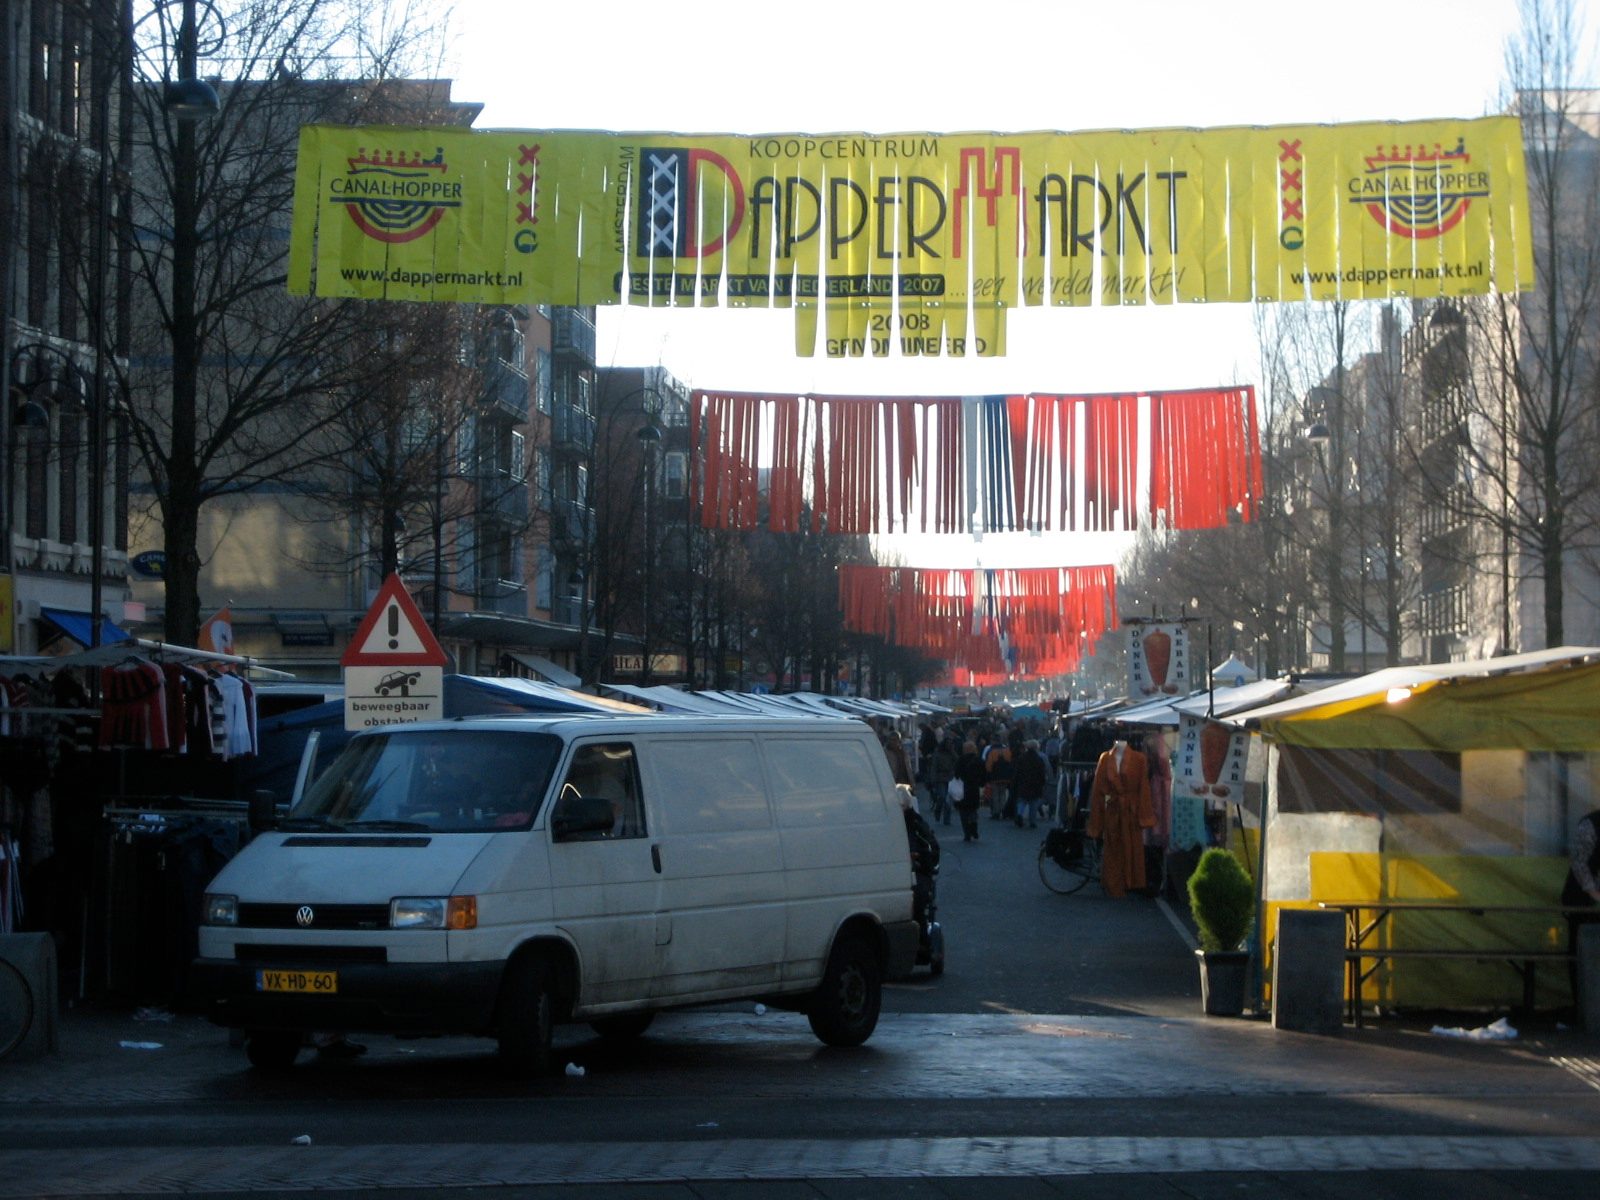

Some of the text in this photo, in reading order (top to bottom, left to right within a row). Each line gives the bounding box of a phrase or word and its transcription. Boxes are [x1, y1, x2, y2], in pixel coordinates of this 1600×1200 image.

[749, 139, 938, 160] KOOPCENTRUM
[330, 177, 463, 198] CANALHOPPER
[1348, 171, 1489, 194] CANALHOPPER
[615, 146, 634, 256] AMSTERDAM
[340, 266, 523, 287] www.dappermarkt.nl
[1290, 261, 1484, 286] www.dappermarkt.nl
[749, 278, 784, 293] VAN
[903, 278, 941, 293] 2007
[871, 313, 931, 331] 2008
[1175, 628, 1184, 679] KEBAB
[352, 701, 430, 713] beweegbaar
[1231, 736, 1244, 780] EBAB
[264, 972, 334, 990] VX-HD-60
